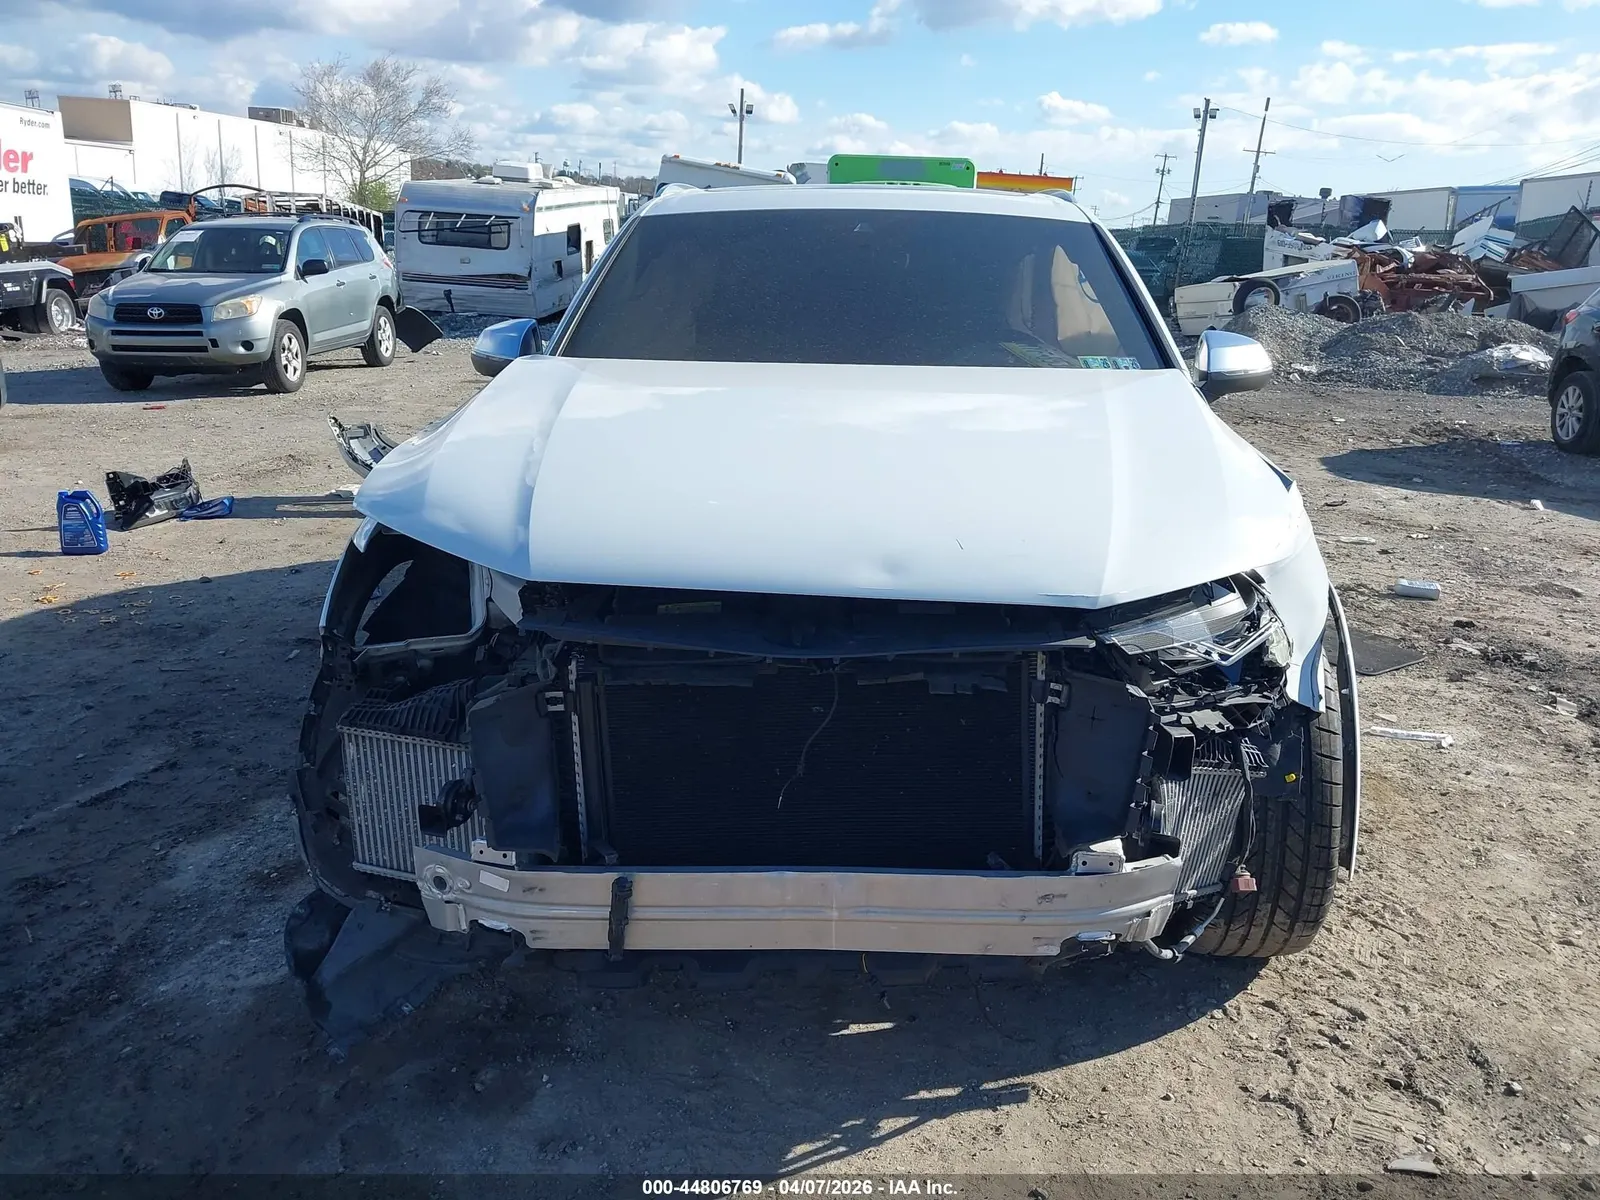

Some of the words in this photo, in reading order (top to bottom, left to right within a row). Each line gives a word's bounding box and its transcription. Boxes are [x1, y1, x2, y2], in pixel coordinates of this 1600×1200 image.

[19, 116, 51, 129] Ryder.com
[0, 138, 34, 173] er
[12, 177, 49, 196] better.
